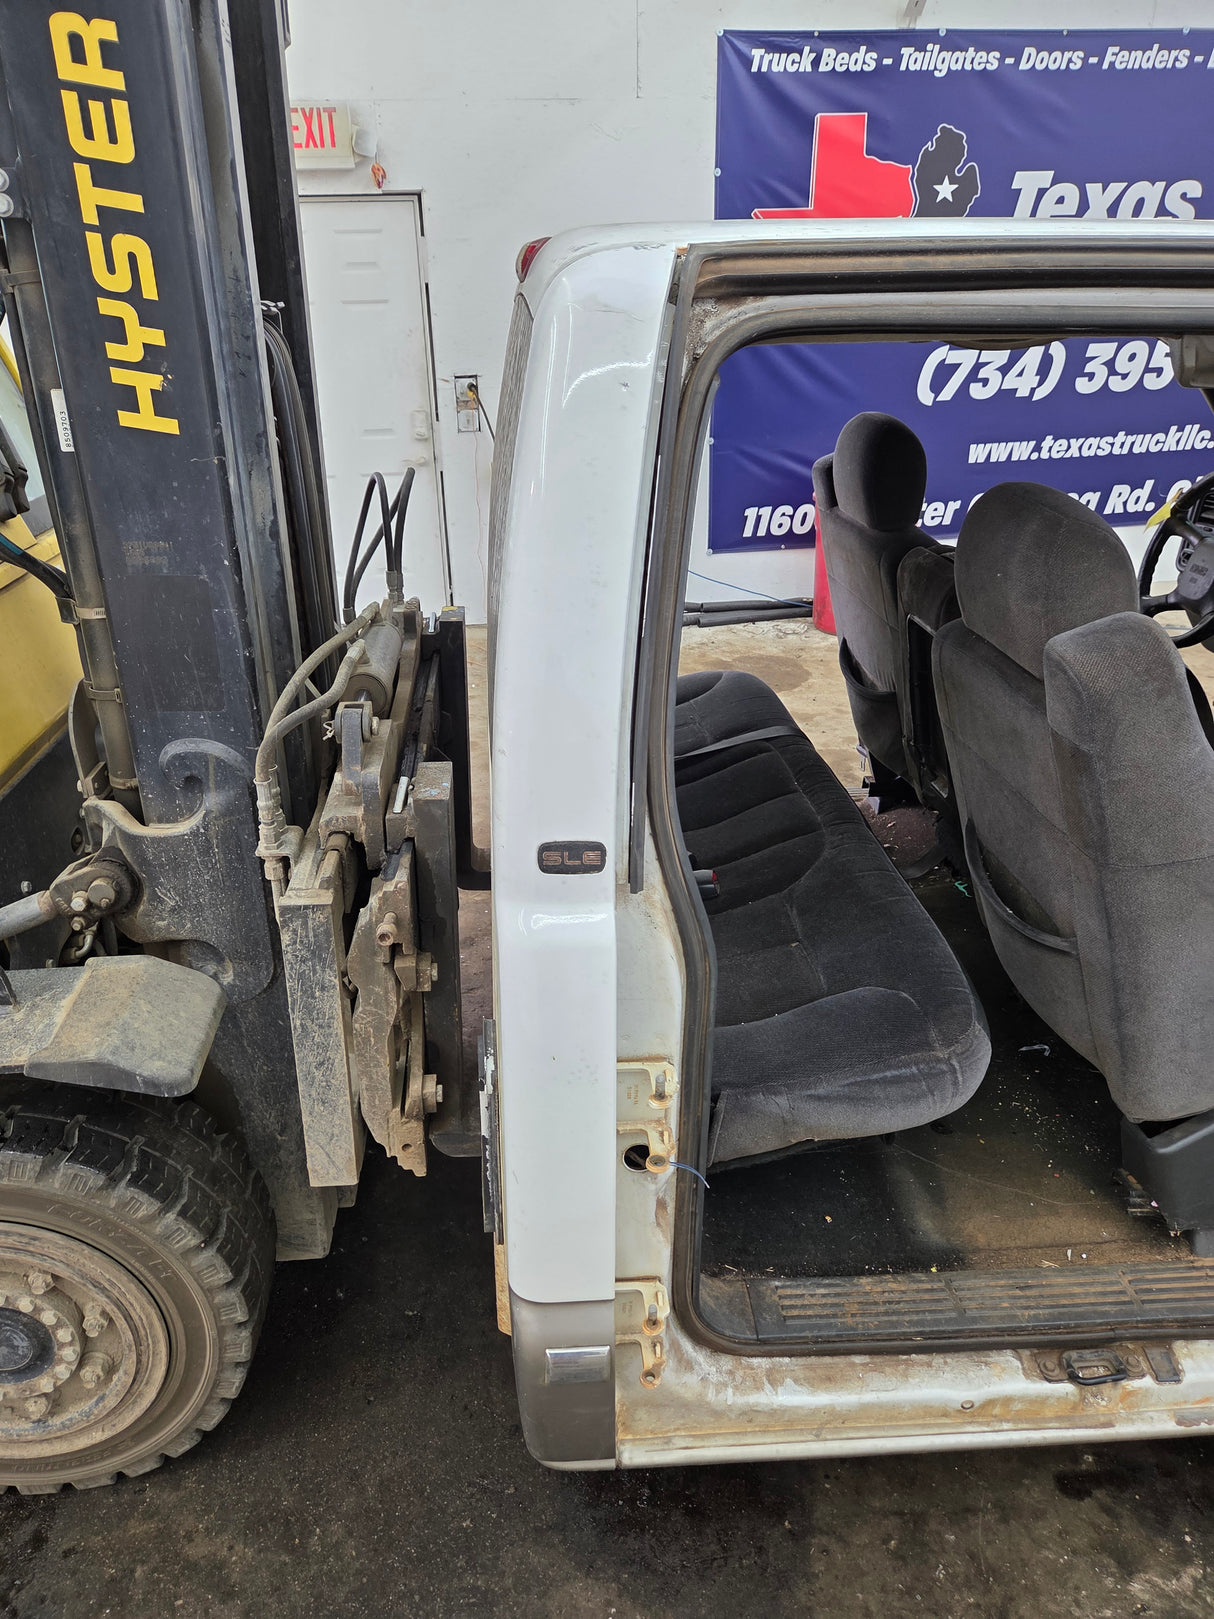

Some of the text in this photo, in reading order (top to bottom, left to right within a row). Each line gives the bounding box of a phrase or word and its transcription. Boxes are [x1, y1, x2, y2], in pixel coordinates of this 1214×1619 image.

[750, 46, 816, 73] Truck
[818, 45, 877, 72] Beds
[900, 43, 1000, 78] Tailgates
[1018, 46, 1085, 71] Doors
[1102, 43, 1191, 70] Fenders
[290, 107, 336, 149] EXIT
[1011, 170, 1203, 219] Texas
[48, 11, 180, 435] HYSTER
[916, 340, 1174, 406] (734) 395
[967, 423, 1214, 464] www.texastruckllc.
[1103, 479, 1156, 515] Rd.
[542, 850, 602, 866] SLE
